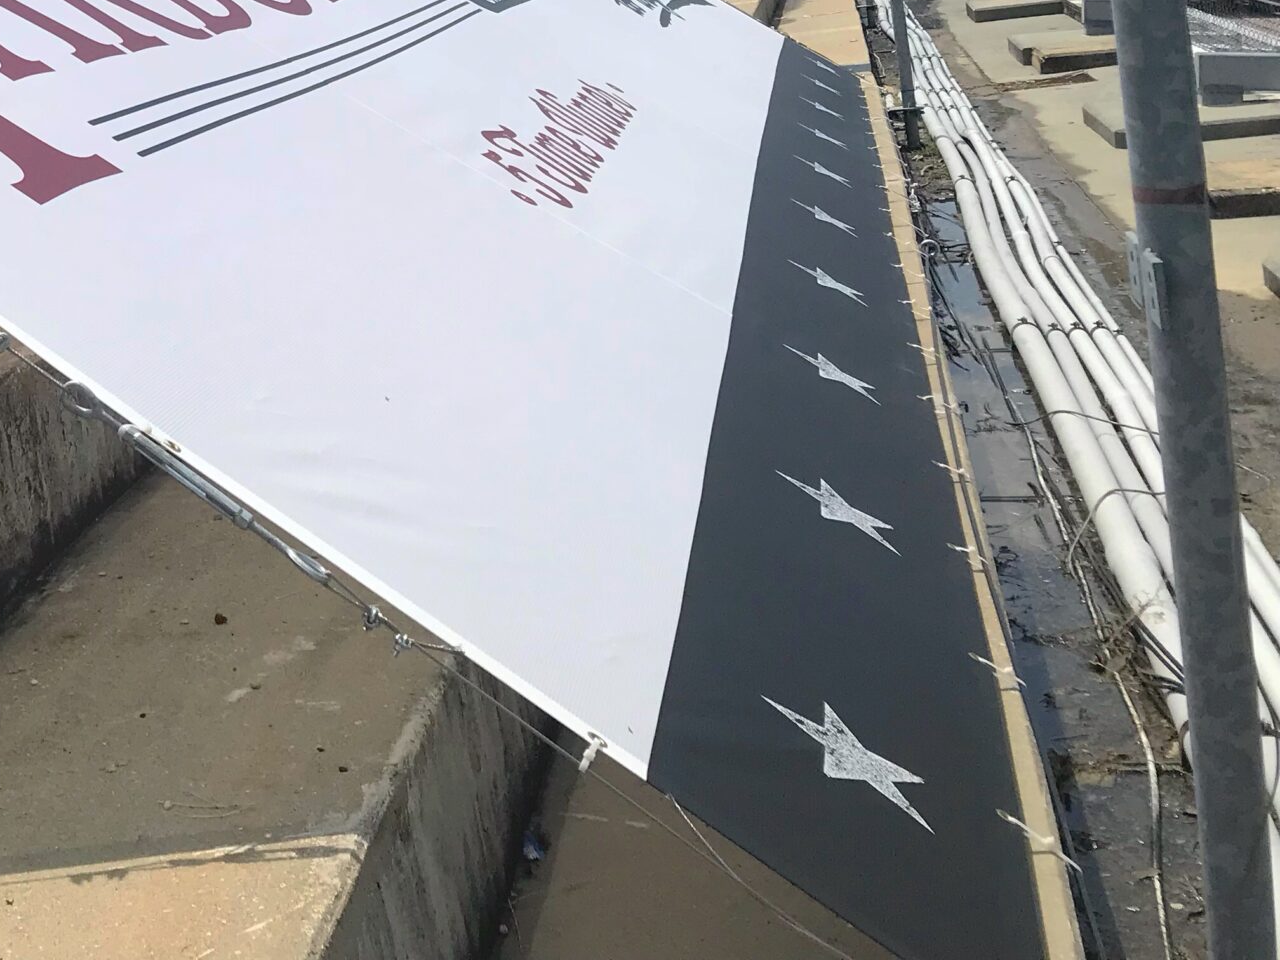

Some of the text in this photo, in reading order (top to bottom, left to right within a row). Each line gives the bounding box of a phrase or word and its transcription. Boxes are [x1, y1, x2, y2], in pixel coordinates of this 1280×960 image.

[481, 79, 637, 208] 5 Time Winner
